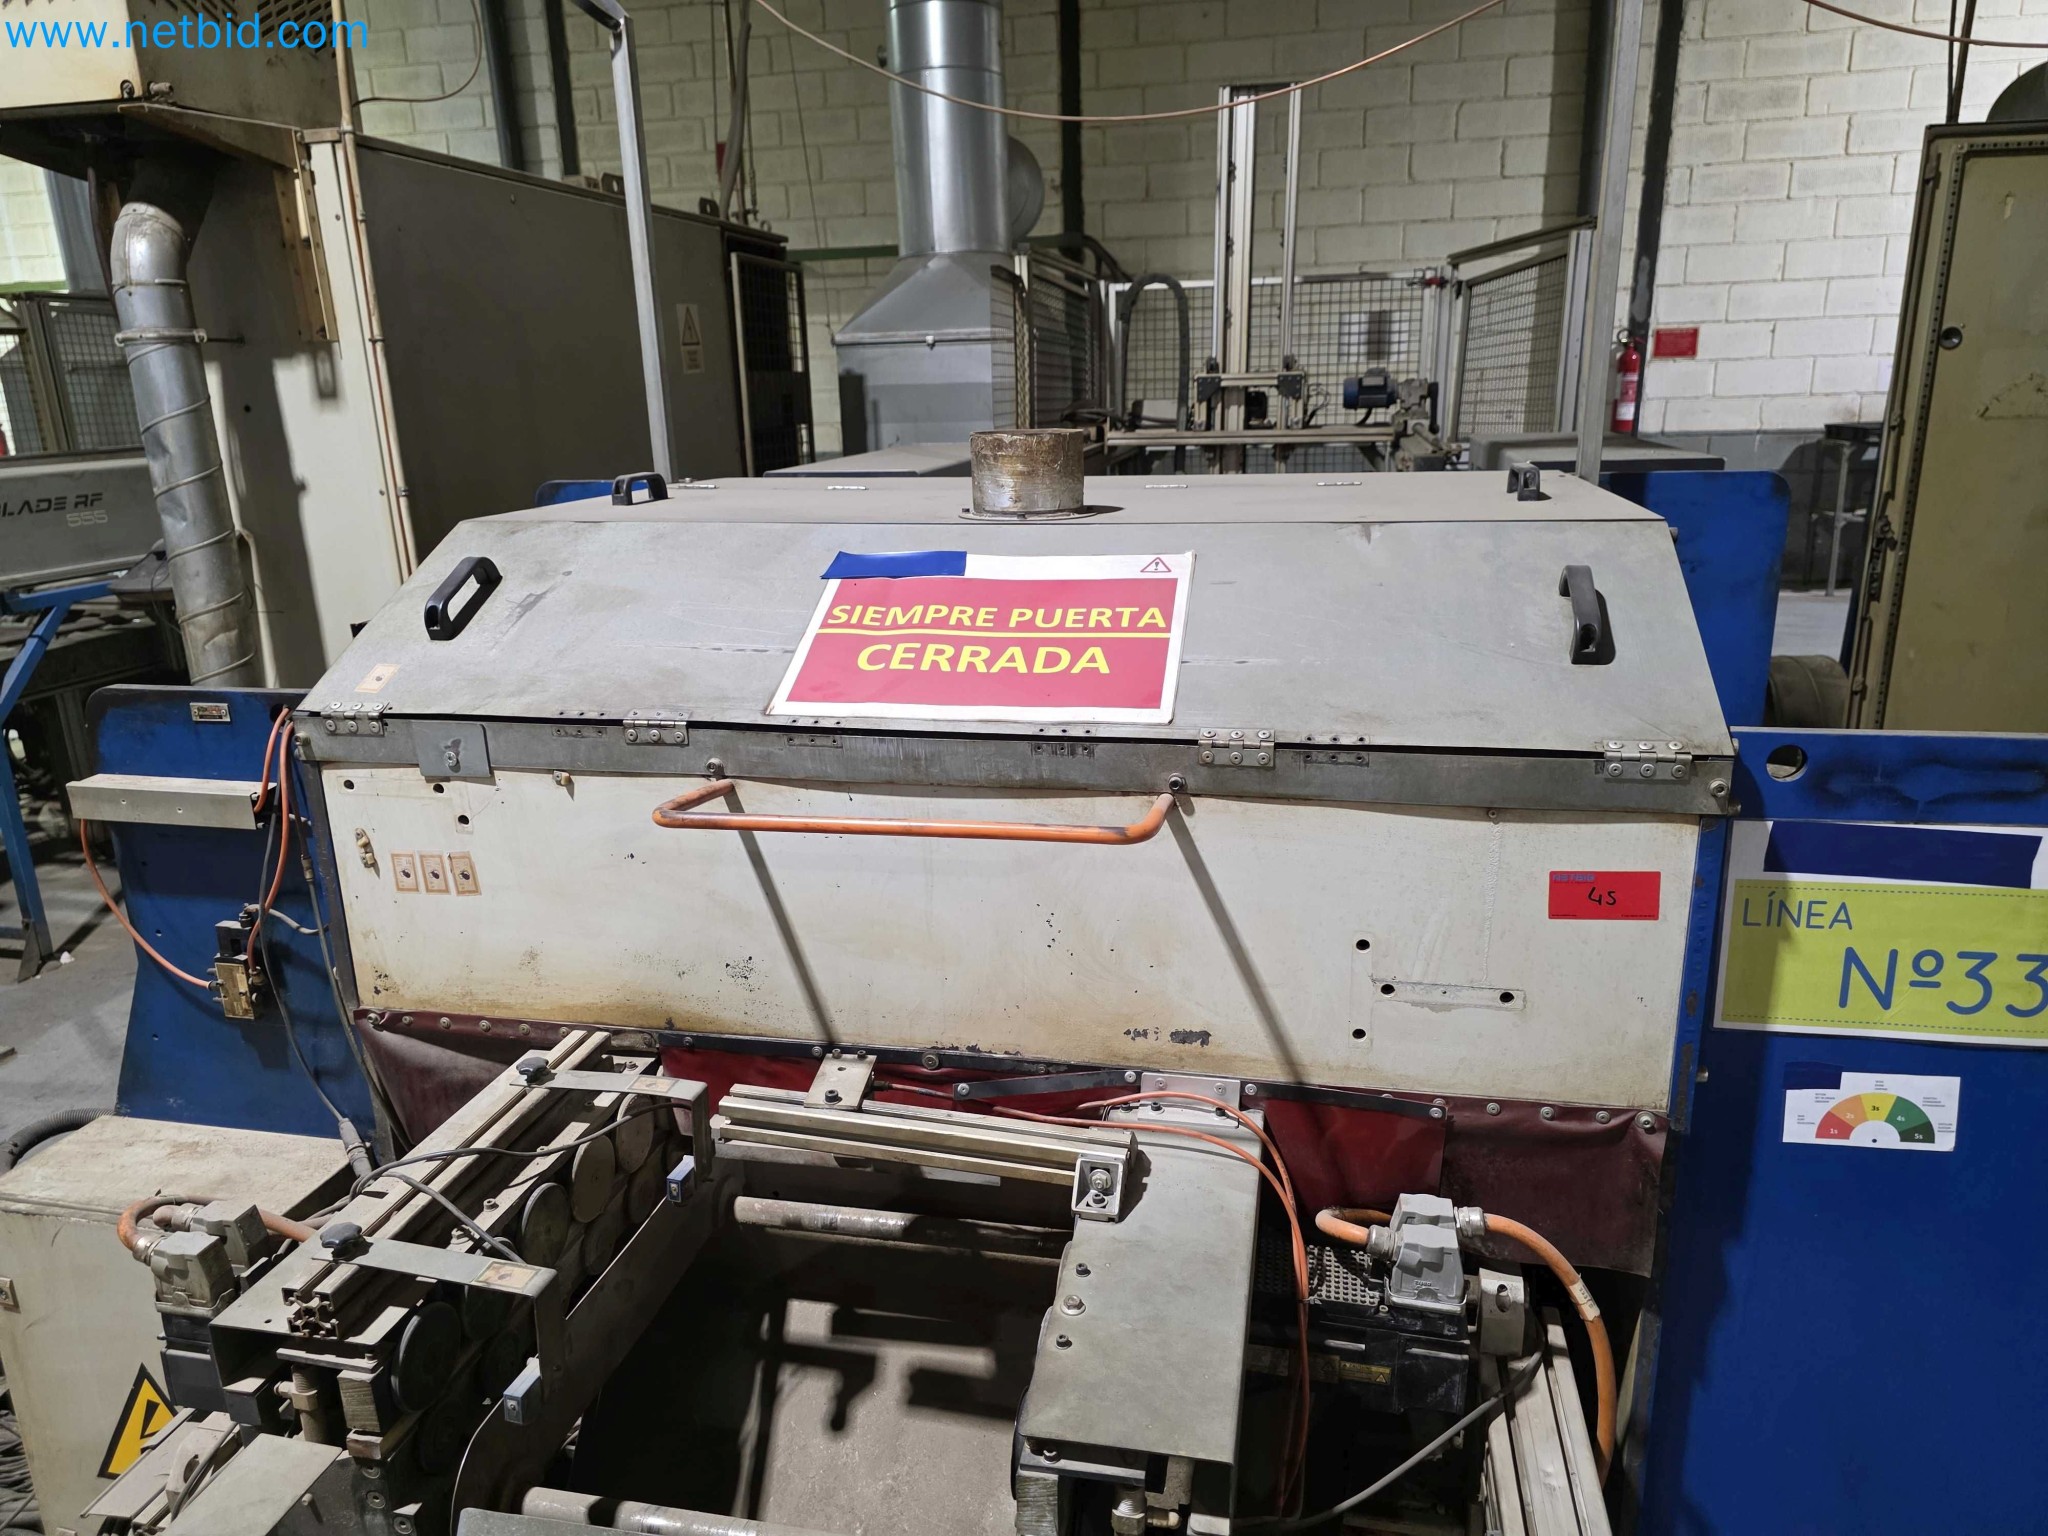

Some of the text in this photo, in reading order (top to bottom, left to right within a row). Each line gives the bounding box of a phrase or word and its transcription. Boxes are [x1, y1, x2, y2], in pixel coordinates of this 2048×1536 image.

[0, 495, 68, 518] LADE
[827, 604, 1166, 629] SIEMPRE PUERTA
[856, 642, 1110, 674] CERRADA
[1587, 886, 1617, 906] 45
[1742, 890, 1853, 930] LÍNEA
[1838, 946, 2048, 1018] Nº33
